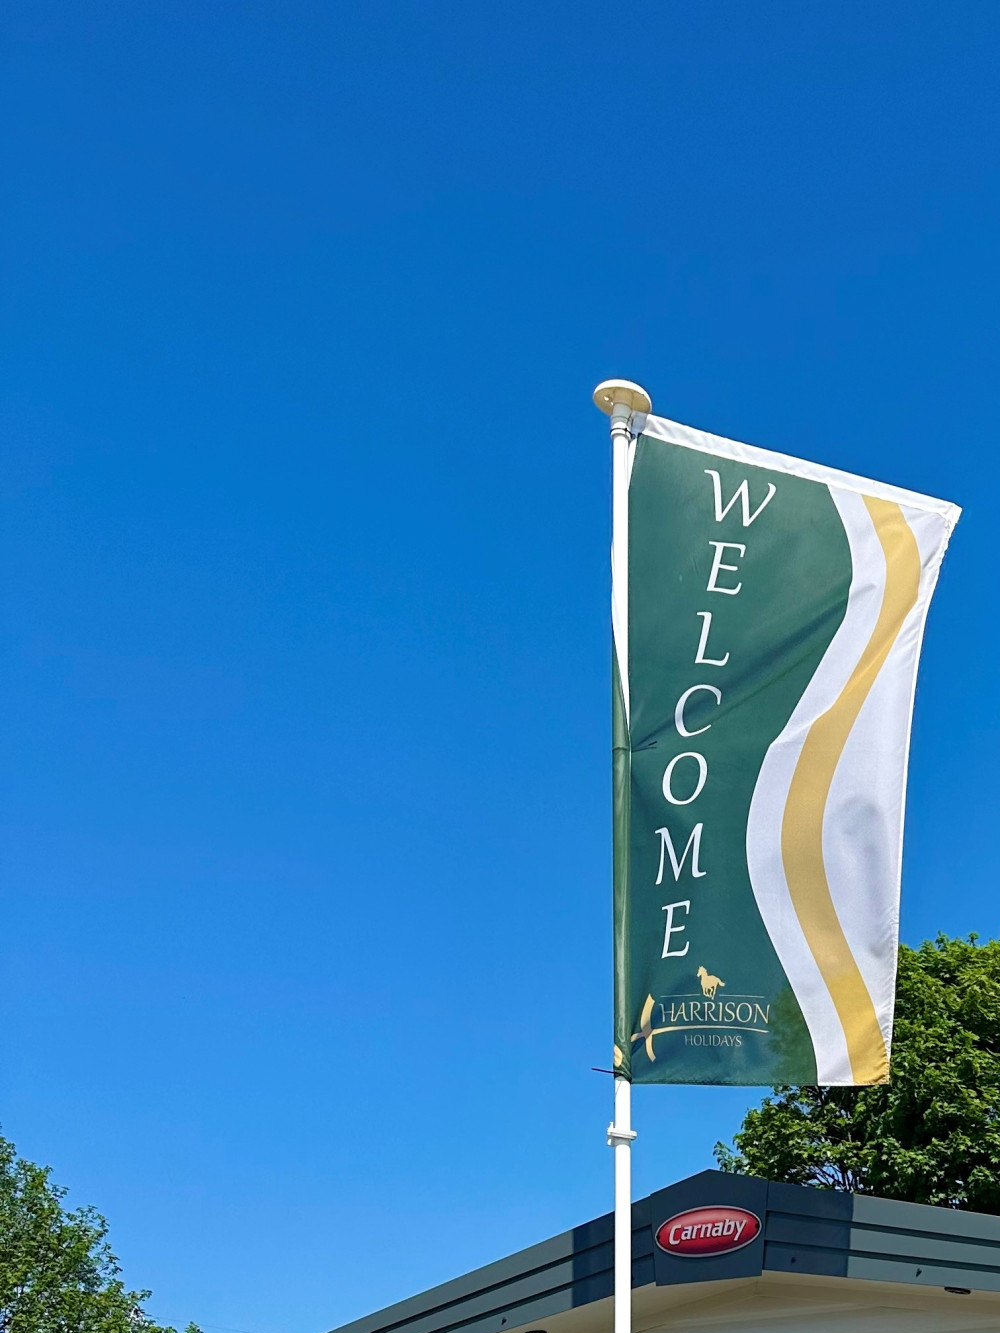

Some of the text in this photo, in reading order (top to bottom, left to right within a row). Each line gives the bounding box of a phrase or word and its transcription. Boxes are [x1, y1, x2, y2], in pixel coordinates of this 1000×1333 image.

[655, 469, 777, 958] WELCOME
[659, 1001, 770, 1024] HARRISON
[684, 1034, 742, 1047] HOLIDAYS
[669, 1219, 747, 1245] Carnaby
